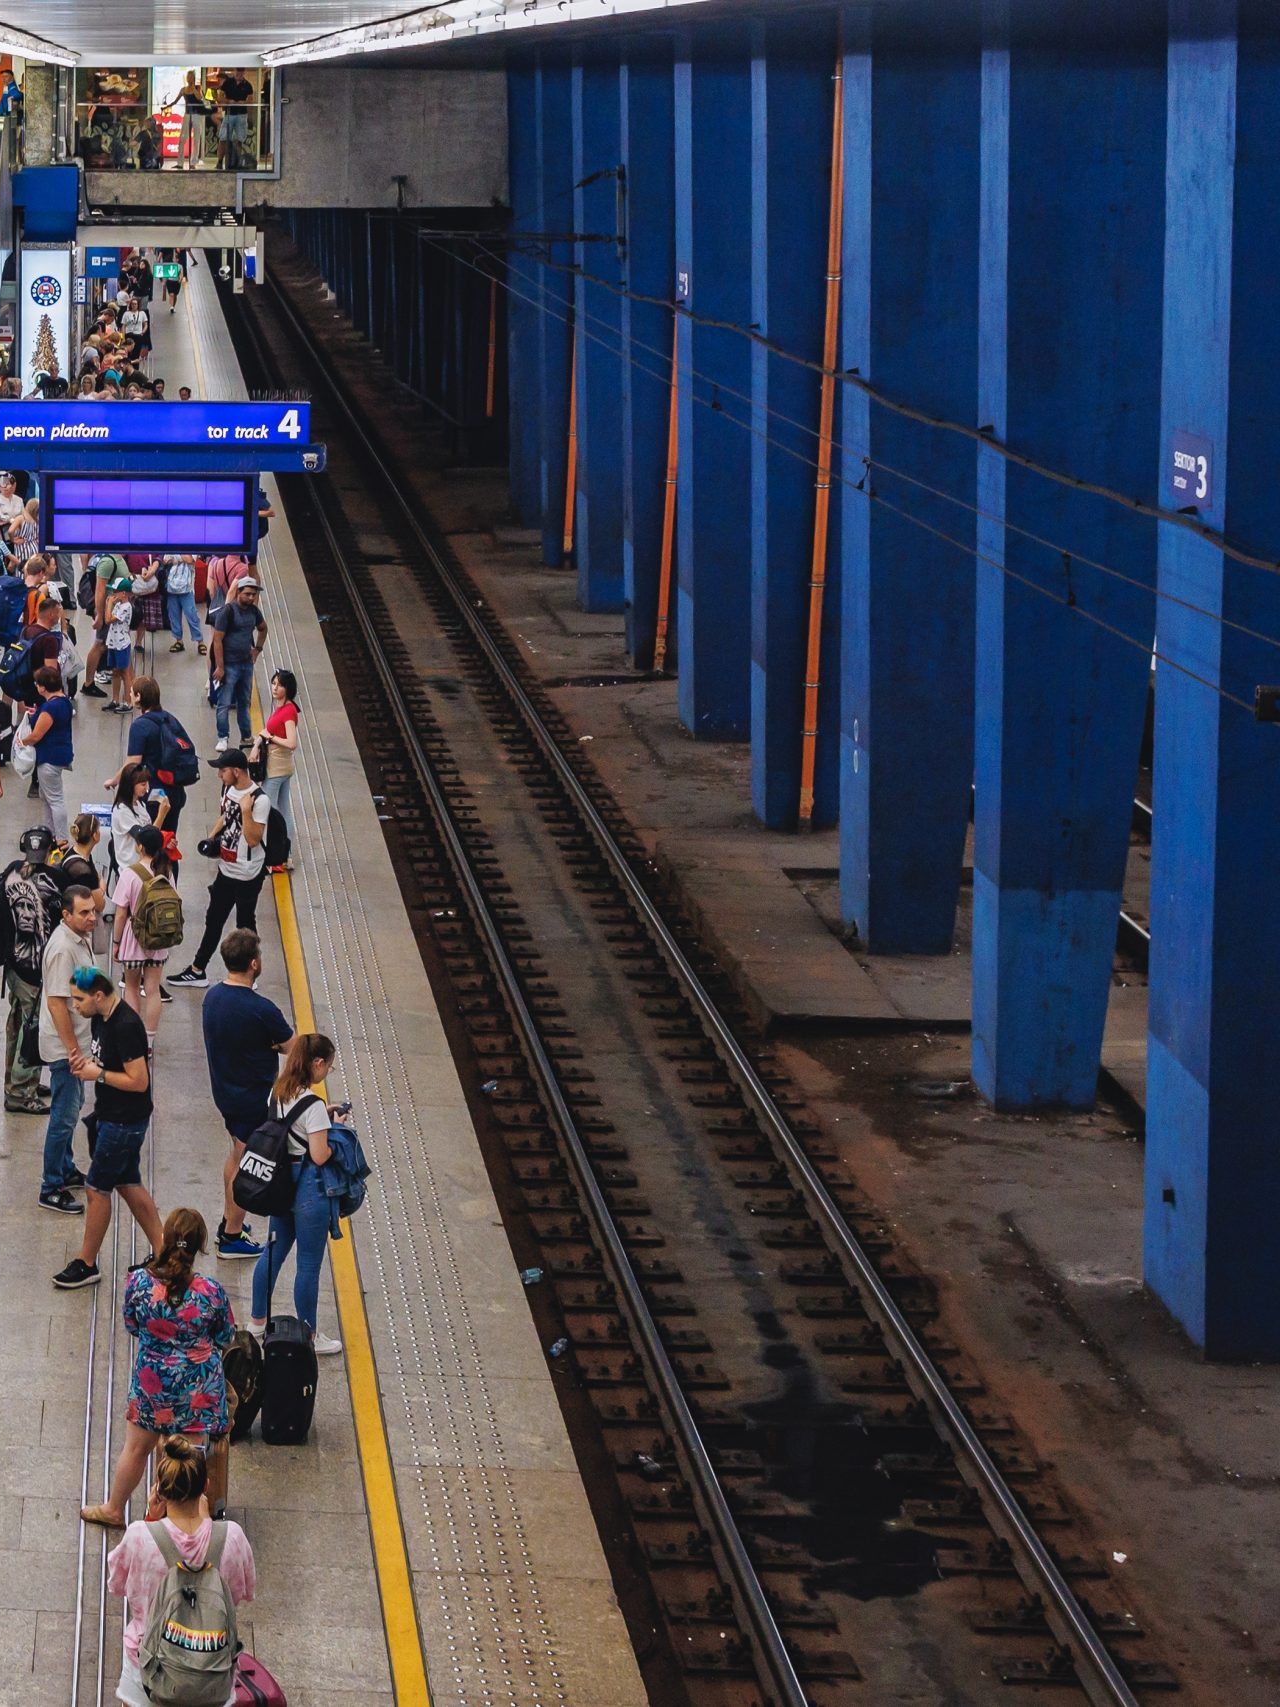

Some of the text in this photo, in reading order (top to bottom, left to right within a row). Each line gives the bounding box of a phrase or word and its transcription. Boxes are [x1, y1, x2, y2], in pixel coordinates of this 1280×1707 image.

[4, 426, 45, 441] peron
[50, 423, 109, 441] platform
[207, 425, 229, 439] tor
[234, 424, 269, 439] track
[277, 409, 301, 439] 4
[1174, 451, 1196, 473] SEKTOR
[1195, 455, 1207, 499] 3
[239, 1150, 277, 1182] VANS
